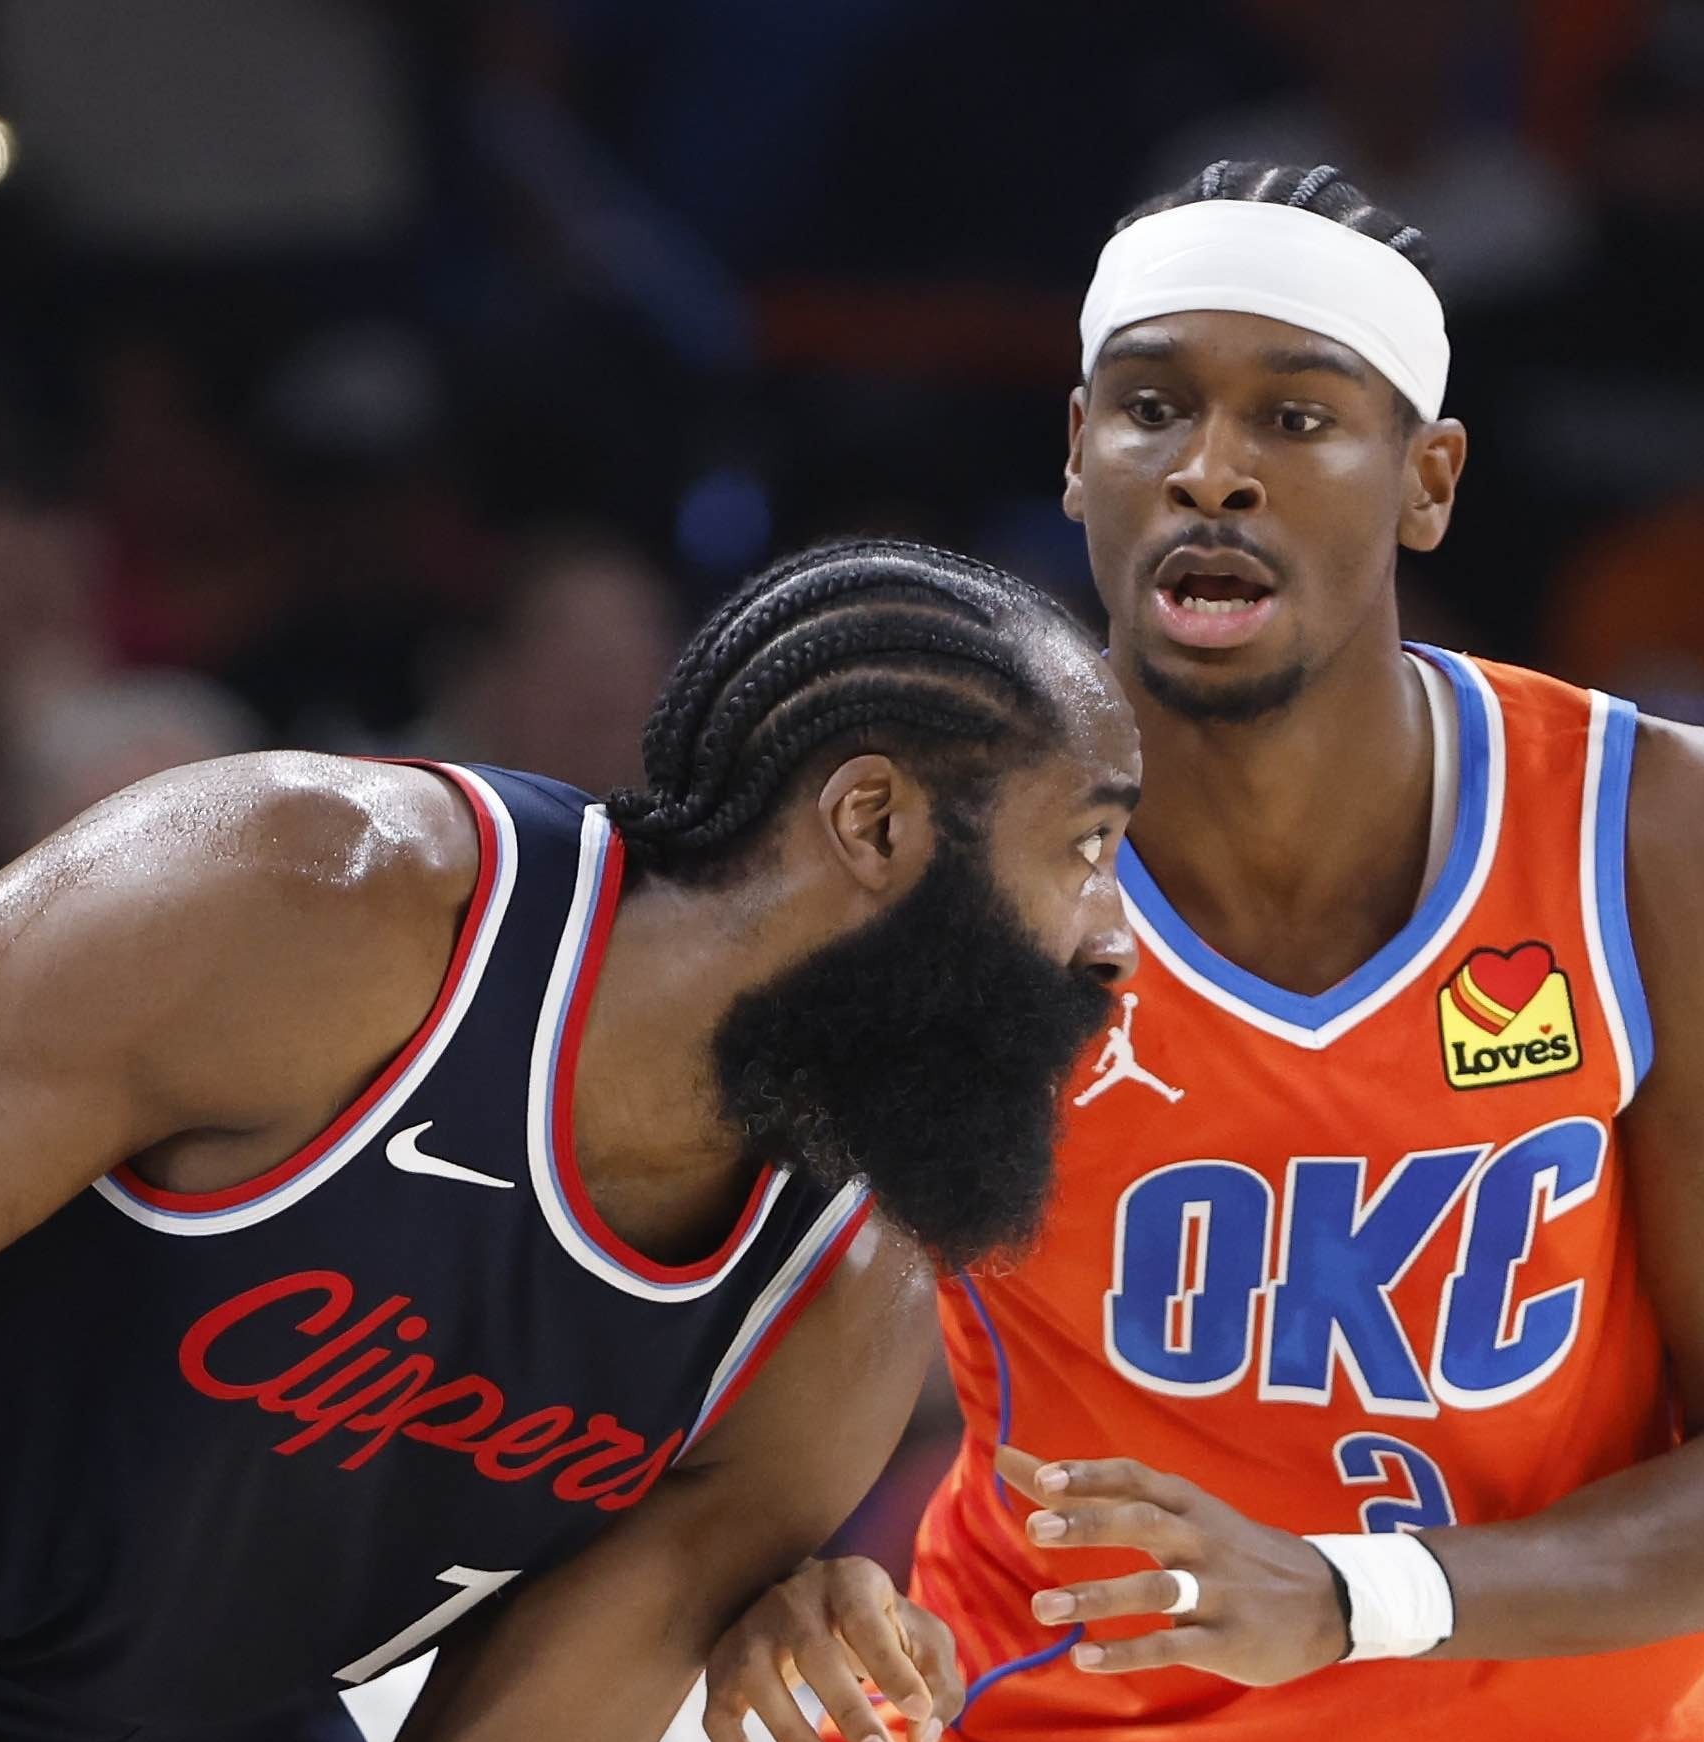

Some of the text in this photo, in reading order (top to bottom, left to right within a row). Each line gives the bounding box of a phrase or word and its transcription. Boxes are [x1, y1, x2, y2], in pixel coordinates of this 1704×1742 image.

[1103, 1116, 1609, 1418] OKC
[178, 1270, 684, 1511] Clippers
[1332, 1431, 1457, 1535] 2
